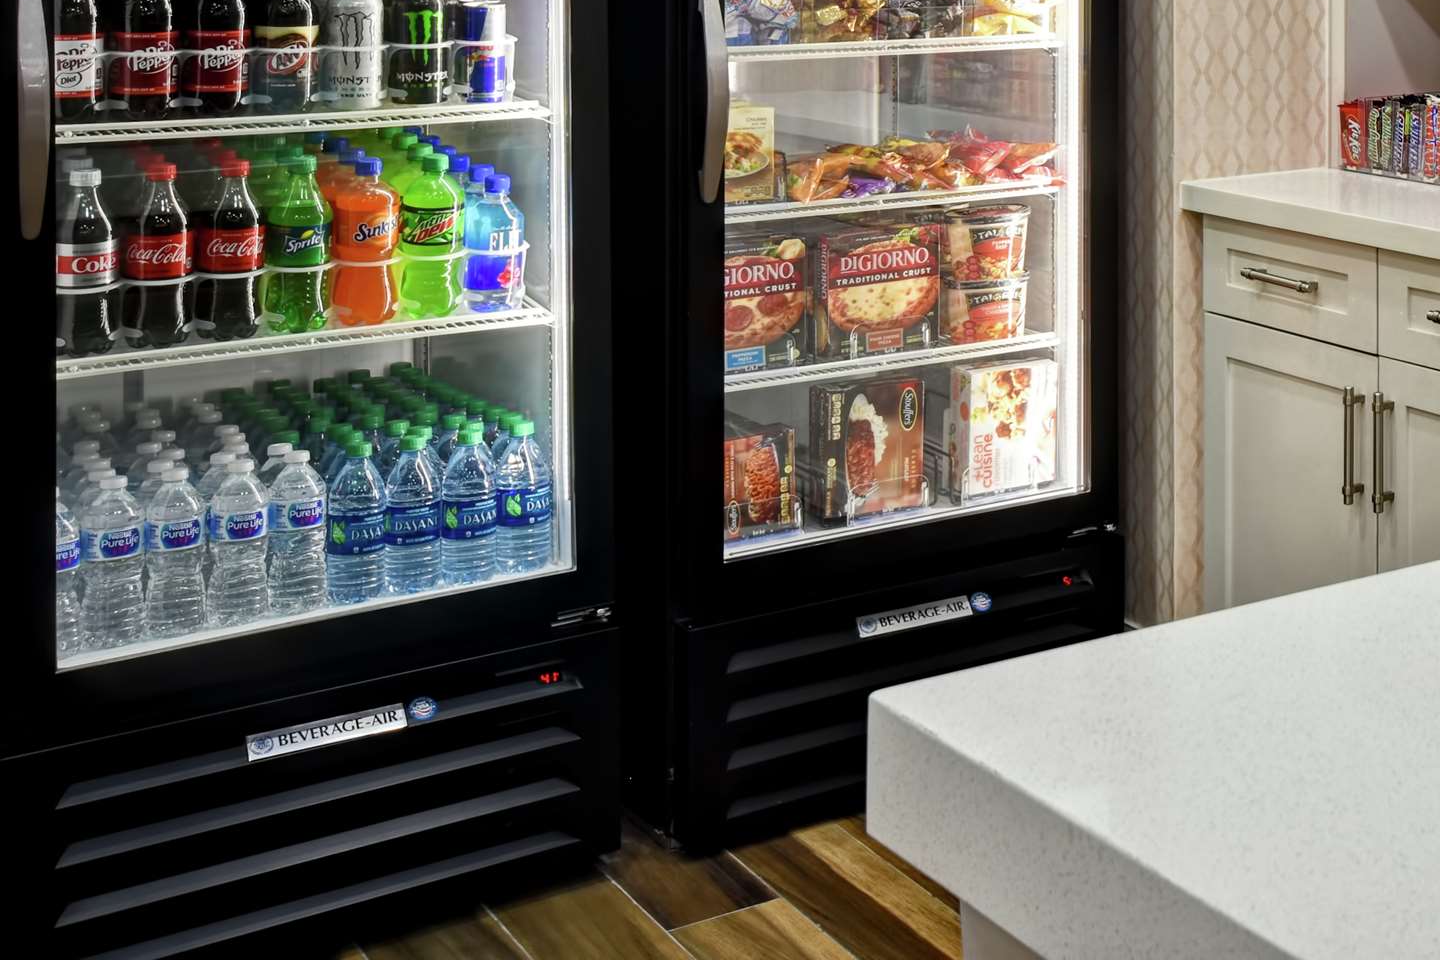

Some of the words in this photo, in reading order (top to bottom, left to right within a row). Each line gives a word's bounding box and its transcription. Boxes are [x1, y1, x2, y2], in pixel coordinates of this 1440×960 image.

[59, 74, 77, 86] Diet
[207, 236, 264, 258] Coca-Cola
[285, 232, 325, 253] Sprite
[71, 255, 117, 274] Coke
[127, 243, 187, 266] Coca-Cola
[725, 261, 794, 286] GIORNO
[836, 272, 899, 286] TRADITIONAL
[903, 267, 931, 279] CRUST
[725, 287, 761, 298] TIONAL
[764, 282, 797, 293] CRUST
[982, 434, 993, 488] cuisine
[527, 497, 551, 511] DASA
[463, 510, 496, 525] DASAN
[351, 525, 384, 542] DASA
[879, 599, 967, 629] BEVERAGE-AIR
[278, 709, 400, 748] BEVERAGE-AIR
